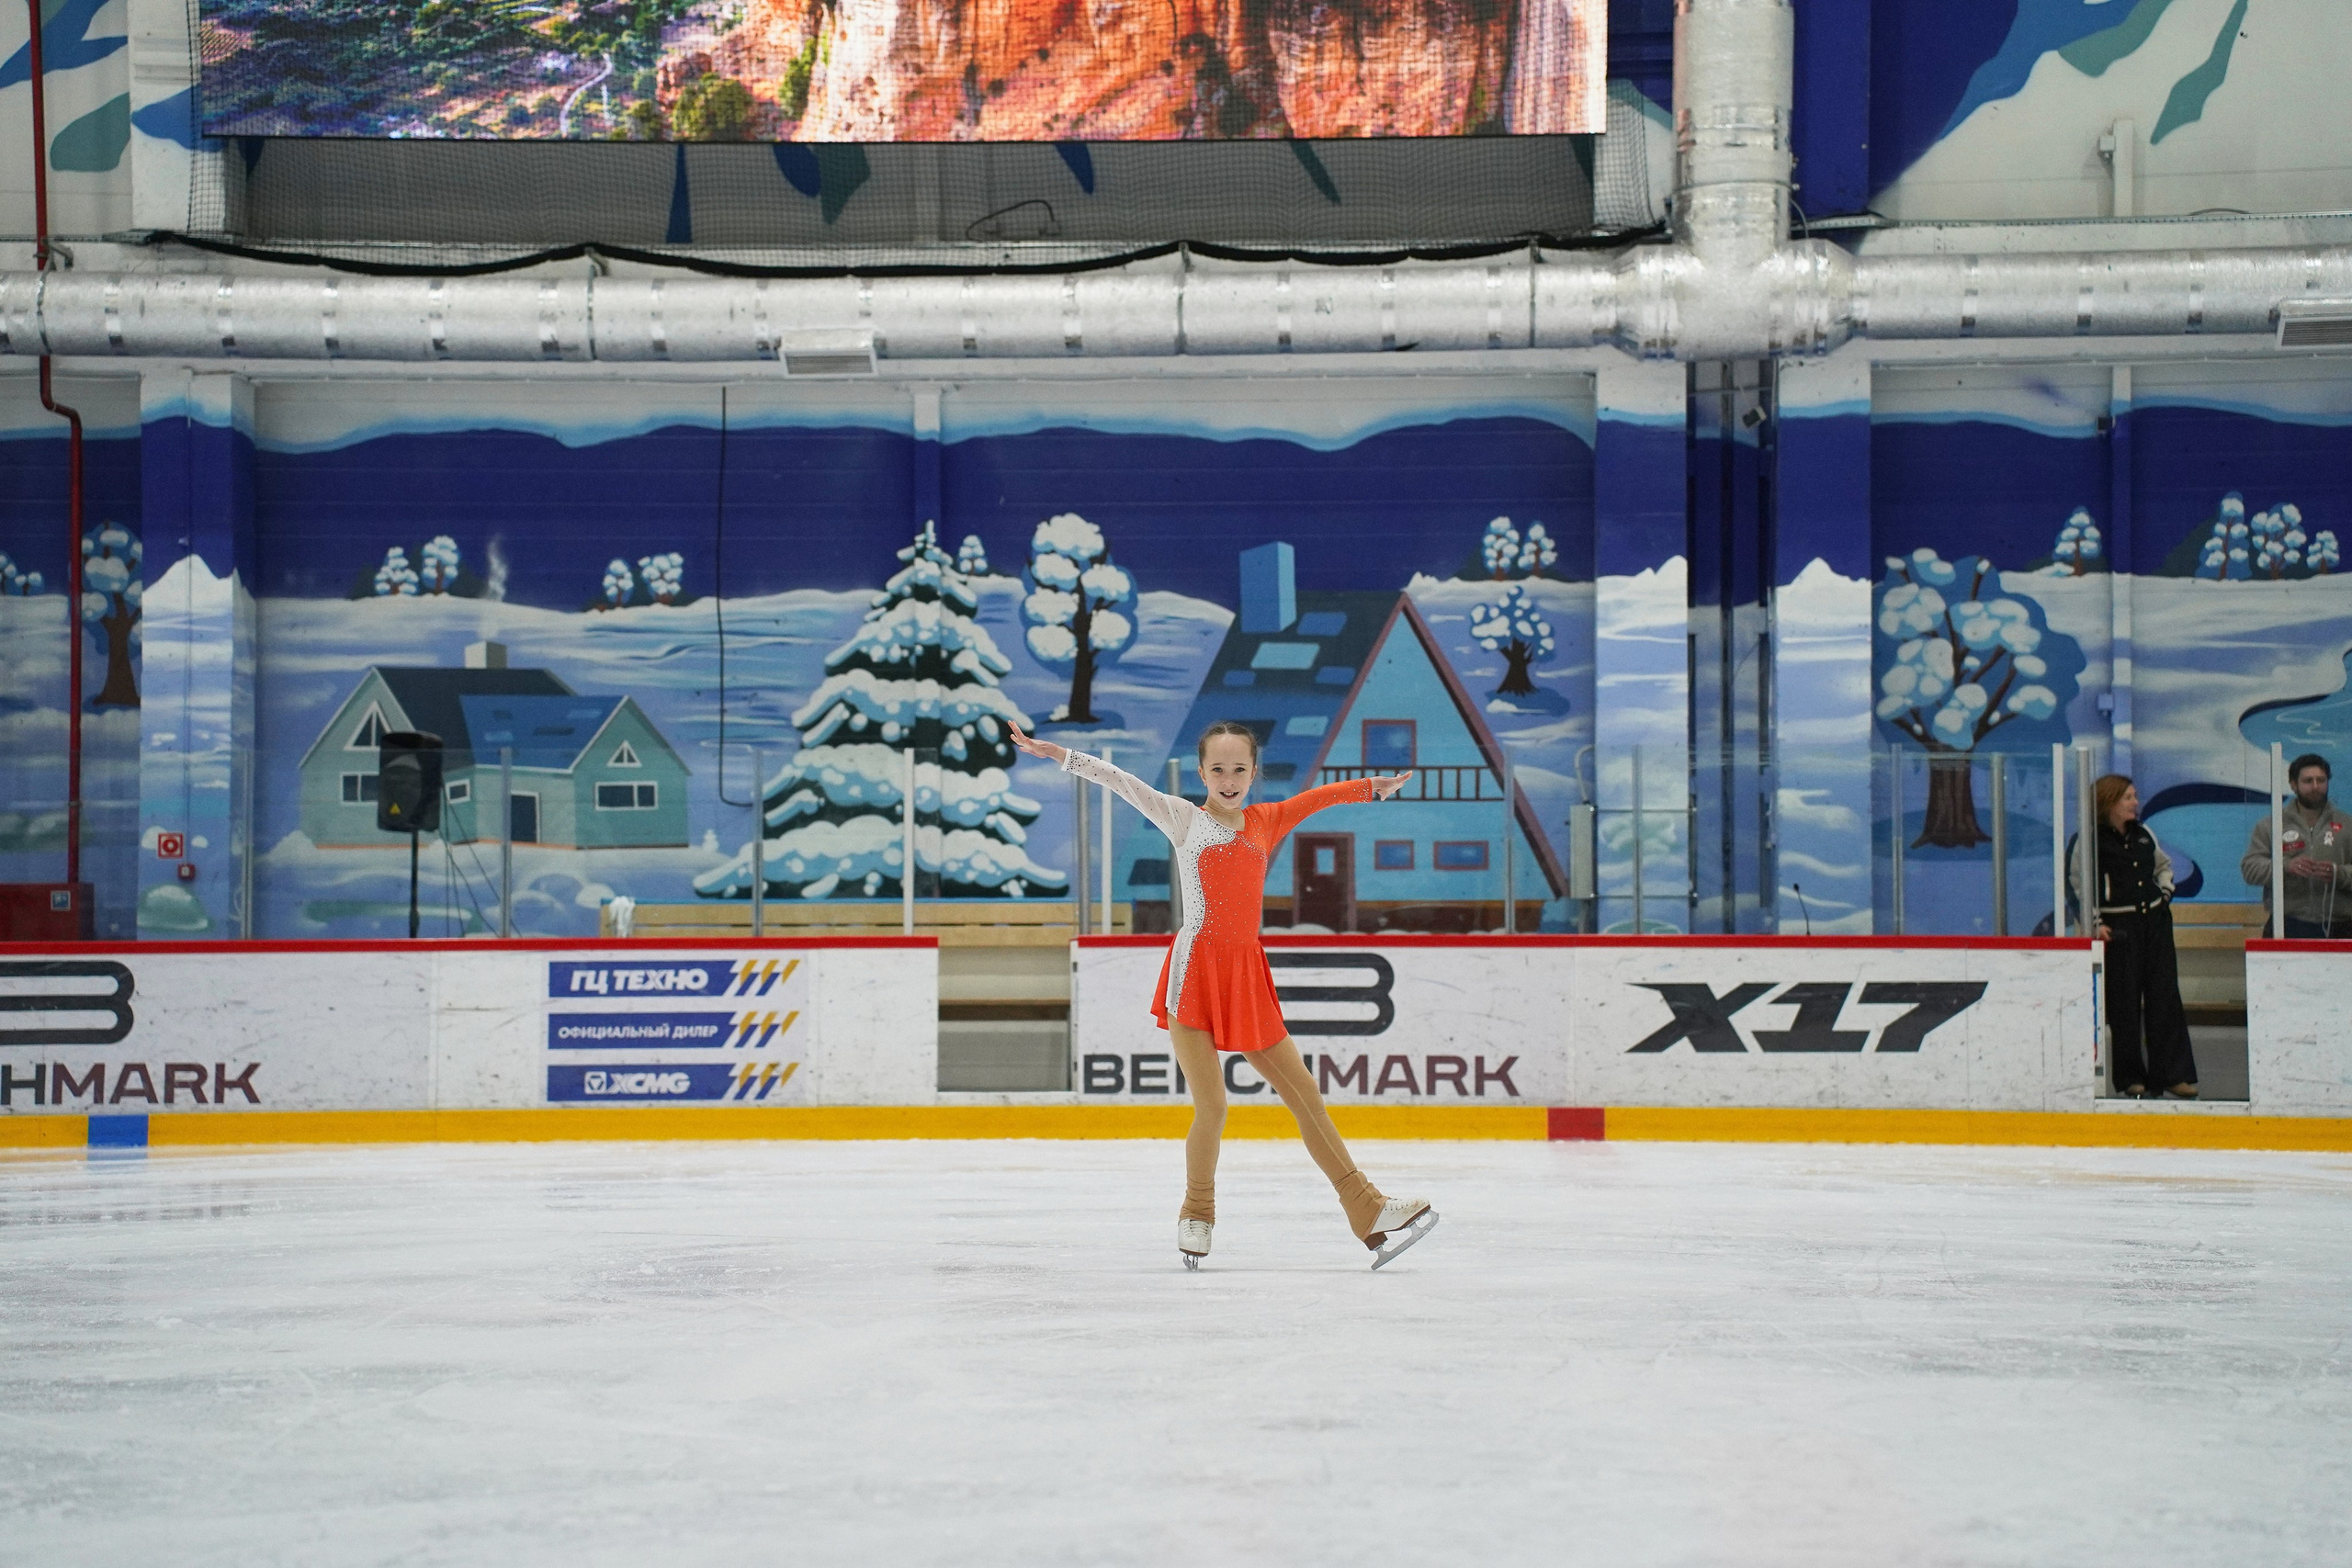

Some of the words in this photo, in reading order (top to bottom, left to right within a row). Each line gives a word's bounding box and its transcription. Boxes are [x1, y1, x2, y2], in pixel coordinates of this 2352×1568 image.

[570, 969, 609, 995] ГЦ
[612, 967, 709, 991] ТЕХНО
[558, 1022, 670, 1040] ОФИЦИАЛЬНЫЙ
[672, 1025, 718, 1040] ДИЛЕР
[1623, 981, 1989, 1053] X17
[0, 1062, 262, 1105] HMARK
[606, 1071, 691, 1095] XCMG
